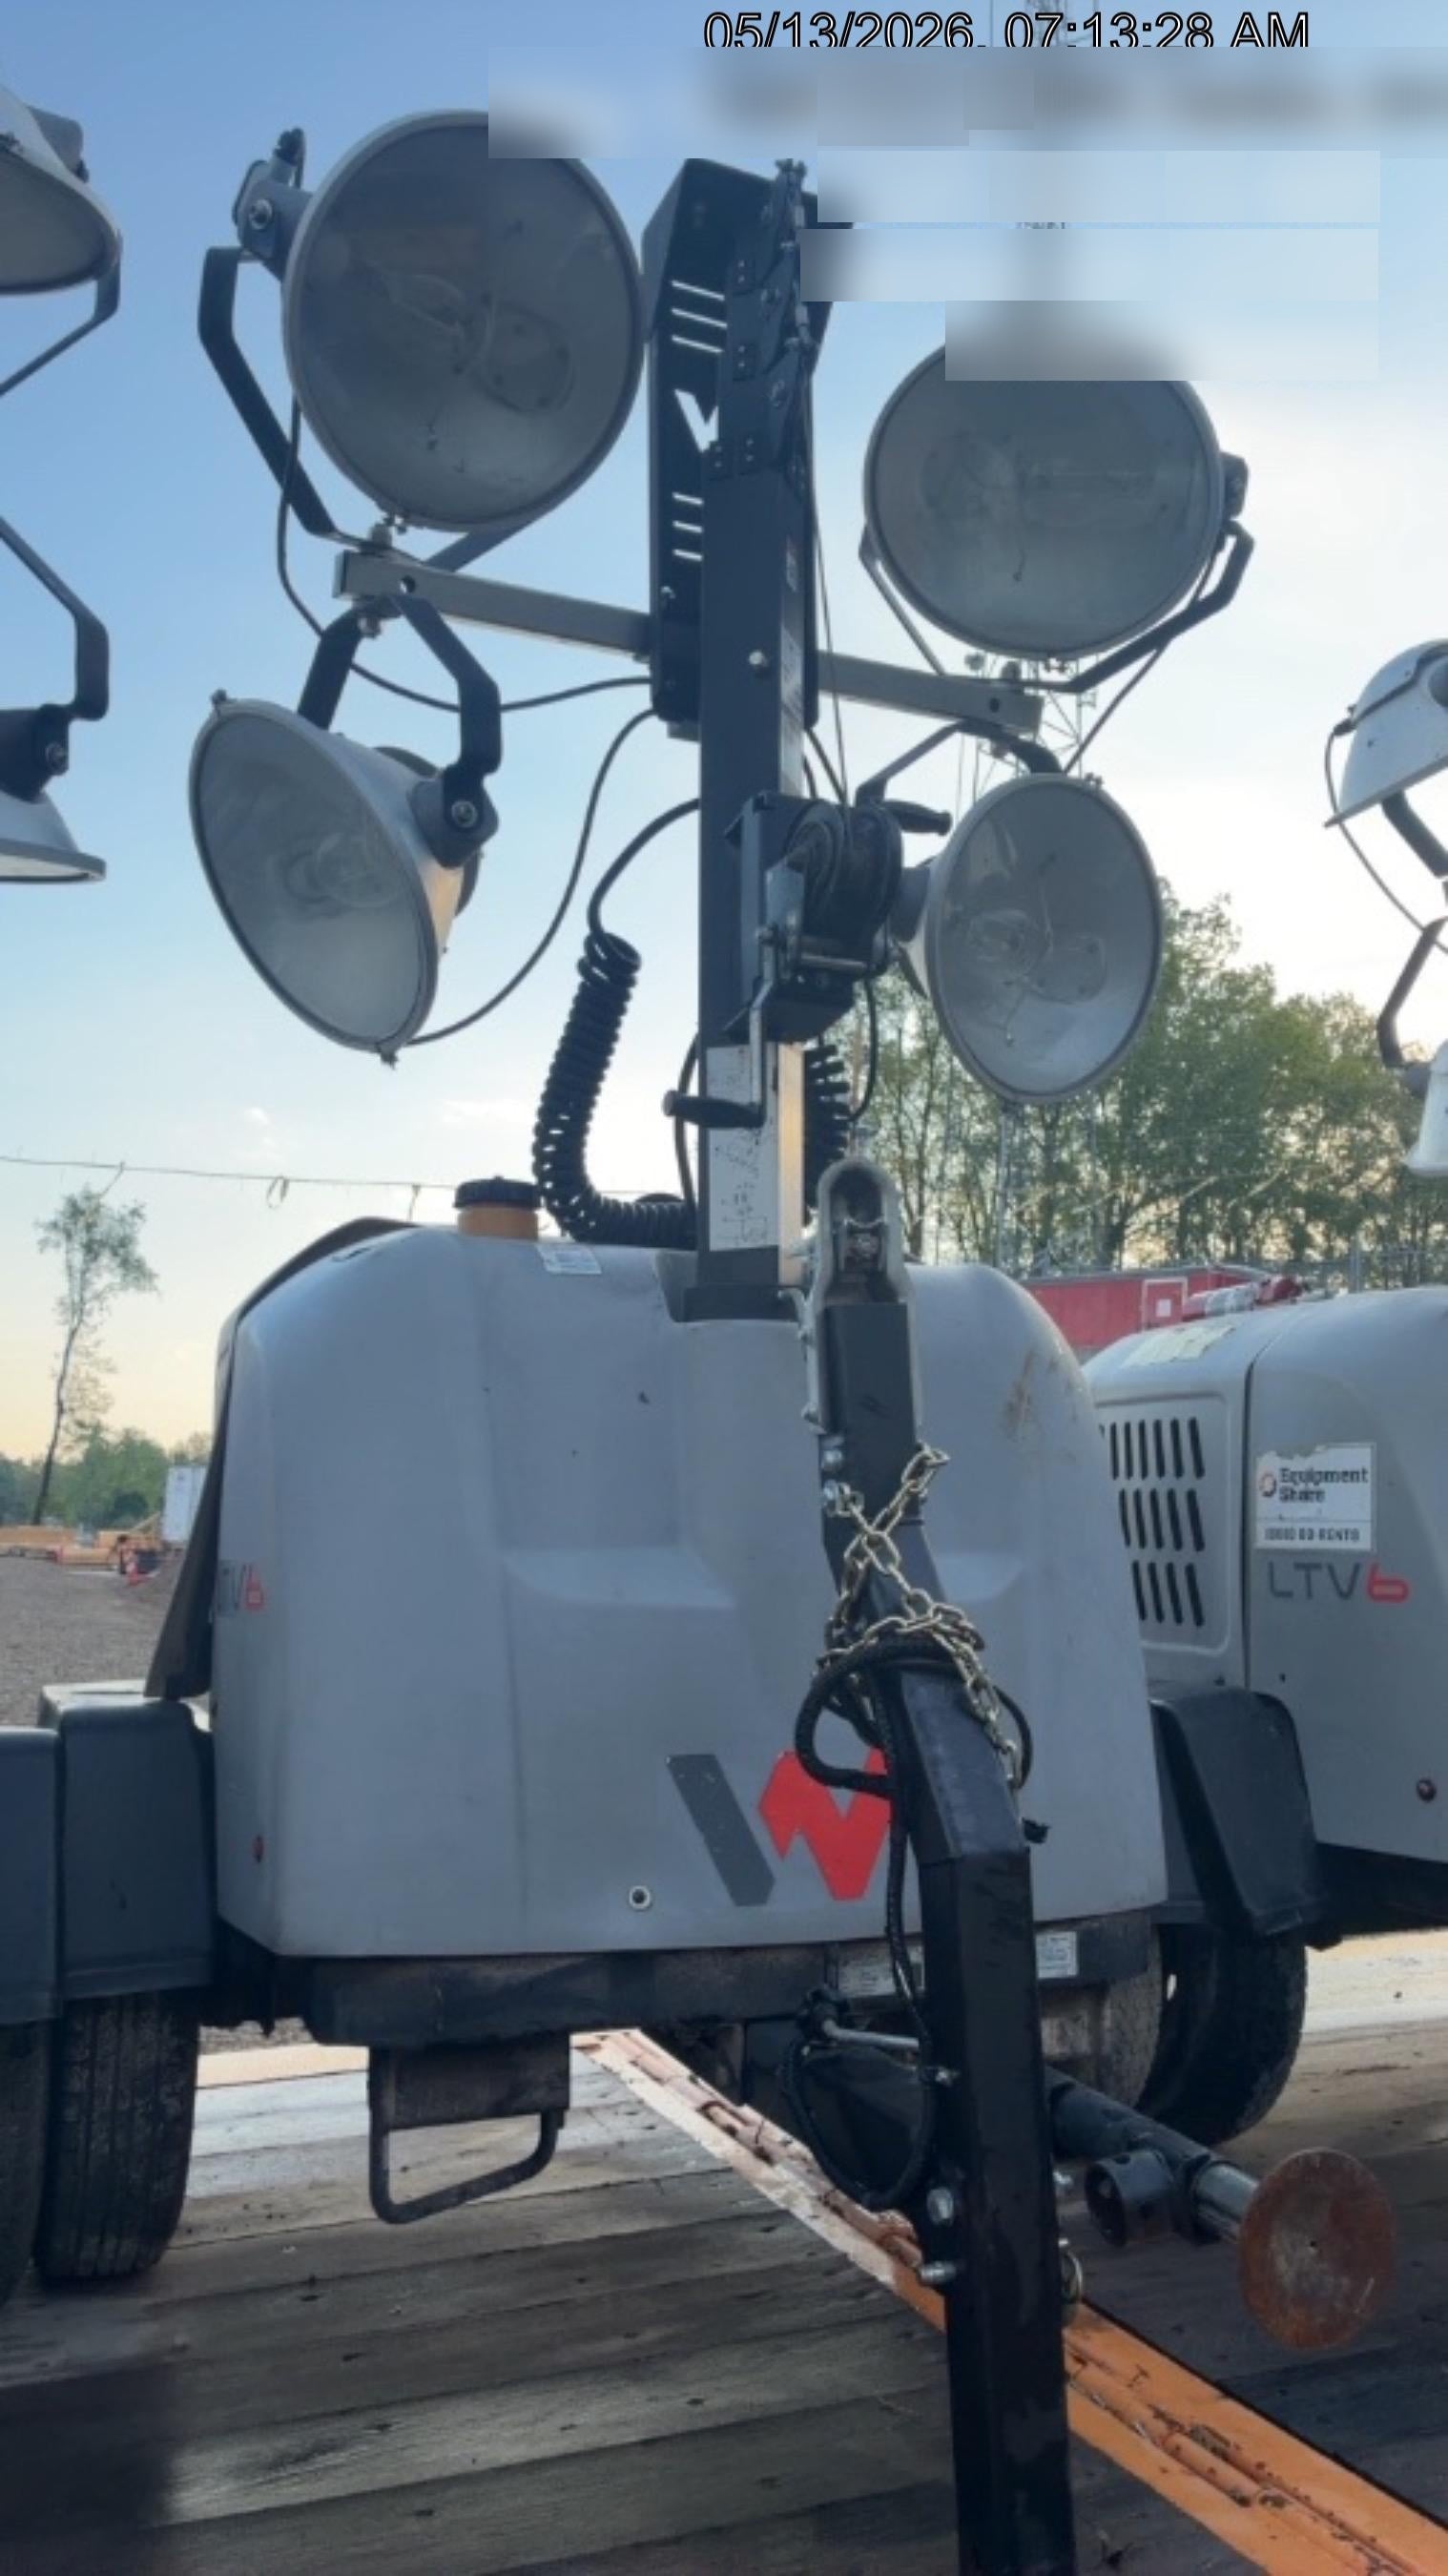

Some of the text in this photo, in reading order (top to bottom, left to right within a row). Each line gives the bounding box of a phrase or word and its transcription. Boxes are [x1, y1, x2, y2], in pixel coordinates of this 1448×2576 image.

[1279, 1467, 1369, 1486] Equipment
[1279, 1486, 1326, 1504] Share
[1268, 1560, 1410, 1604] LTV6
